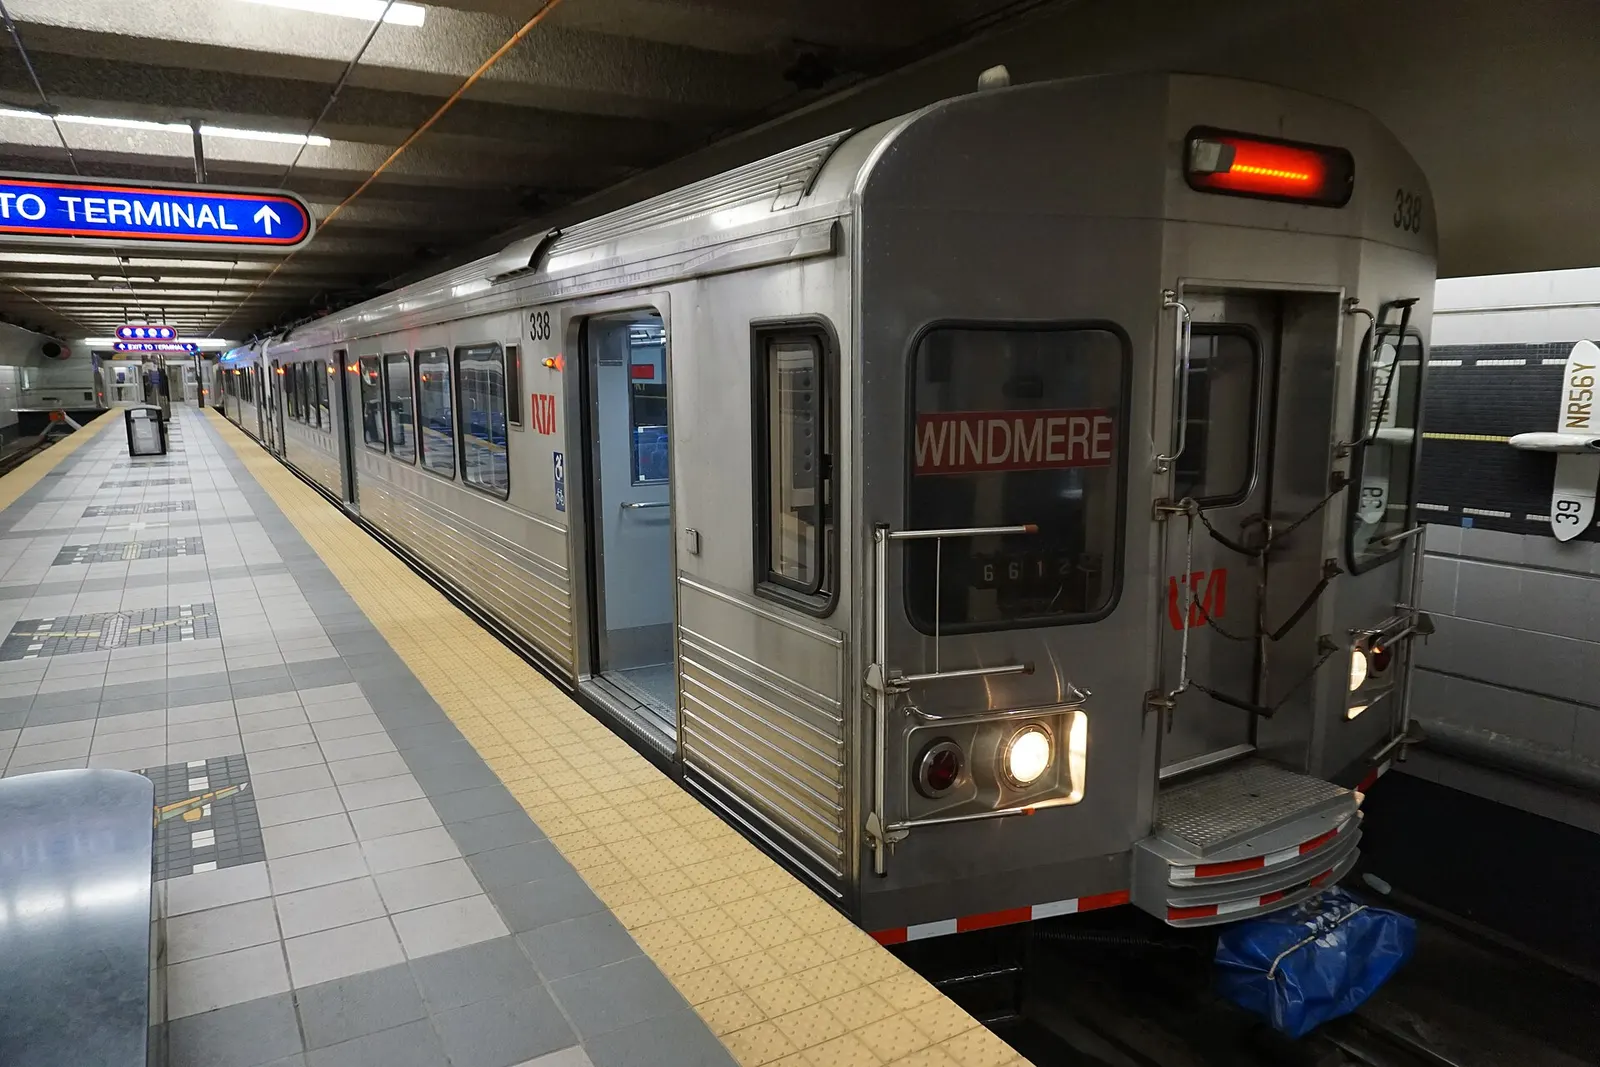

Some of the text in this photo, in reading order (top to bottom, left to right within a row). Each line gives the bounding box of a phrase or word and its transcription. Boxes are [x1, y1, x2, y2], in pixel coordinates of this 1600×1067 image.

[0, 192, 238, 230] TO TERMINAL
[1394, 188, 1422, 234] 338
[530, 310, 551, 341] 338
[1566, 362, 1596, 428] NR56Y
[914, 416, 1113, 467] WINDMERE
[1555, 500, 1582, 525] 39
